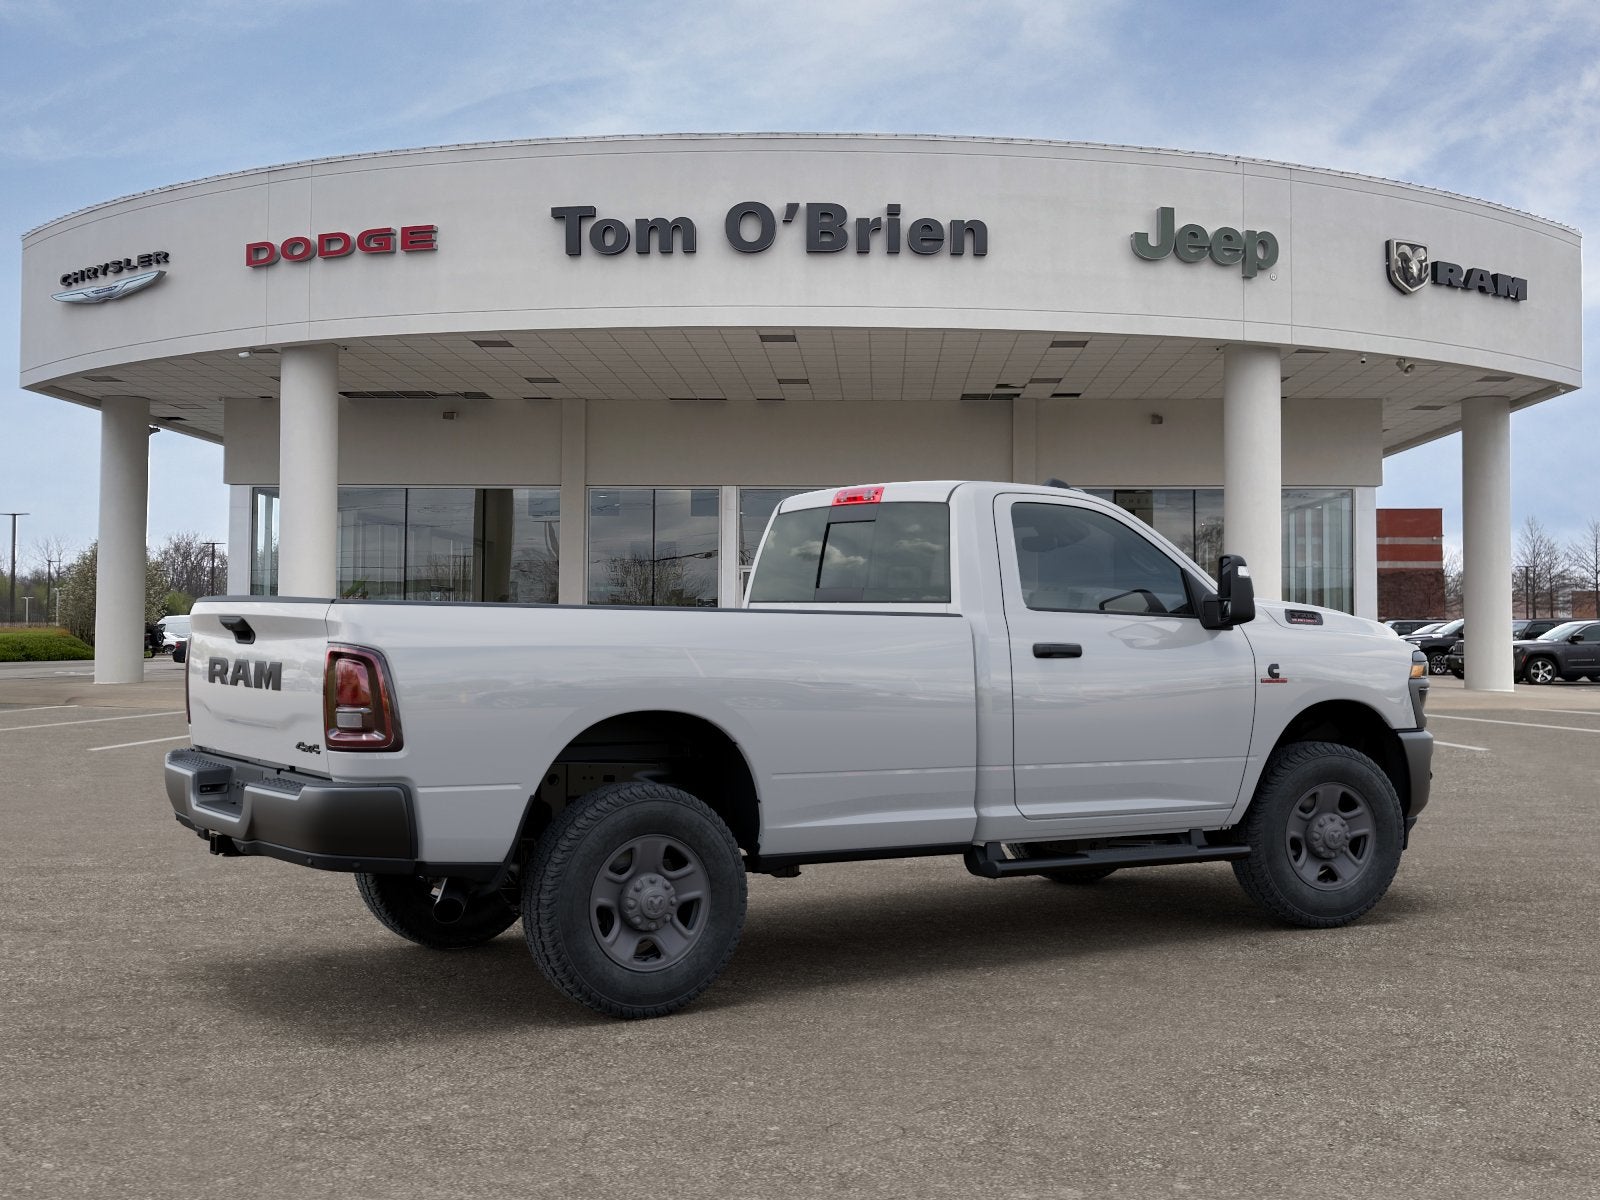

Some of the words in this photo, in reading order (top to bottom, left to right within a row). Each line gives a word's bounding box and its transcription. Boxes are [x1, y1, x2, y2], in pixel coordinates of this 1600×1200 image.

[245, 224, 438, 269] DODGE
[551, 205, 697, 256] Tom
[725, 201, 988, 256] O'Brien
[1130, 206, 1280, 279] Jeep
[59, 250, 170, 287] CHRYSLER
[1431, 260, 1528, 301] RAM
[208, 656, 283, 691] RAM
